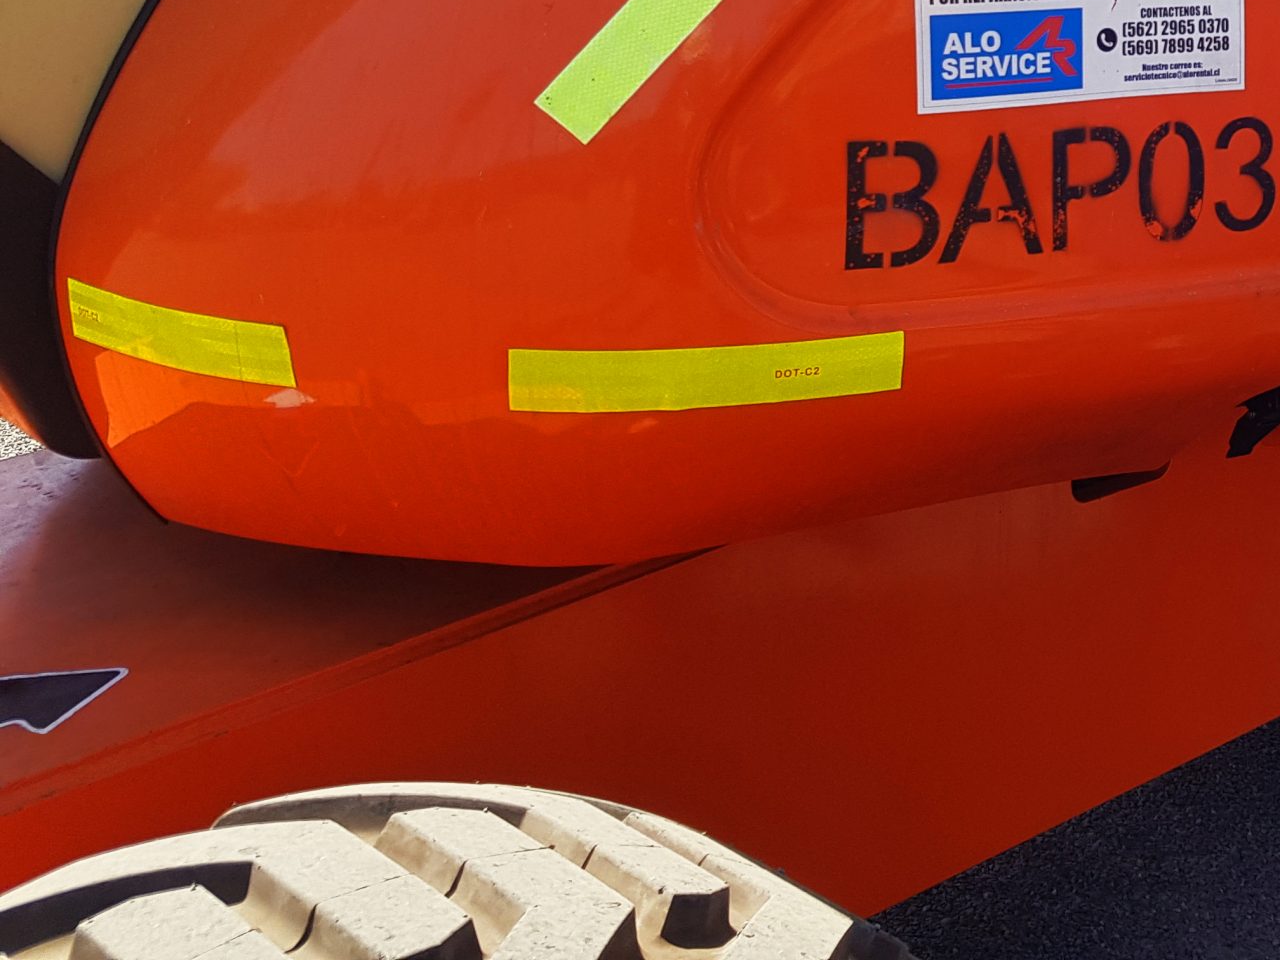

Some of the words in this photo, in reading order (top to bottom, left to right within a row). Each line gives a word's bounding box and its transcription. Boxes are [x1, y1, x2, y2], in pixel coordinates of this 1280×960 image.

[1140, 5, 1201, 18] CONTACTENOS
[1202, 5, 1212, 15] AL
[1122, 20, 1158, 38] (562)
[1161, 19, 1195, 36] 2965
[1198, 18, 1229, 34] 0370
[942, 30, 1002, 55] ALO
[1122, 39, 1159, 56] (569)
[1161, 38, 1195, 54] 7899
[1197, 35, 1230, 52] 4258
[941, 51, 1052, 81] SERVICE
[1142, 63, 1168, 71] Nuestro
[774, 366, 821, 379] DOT-C2
